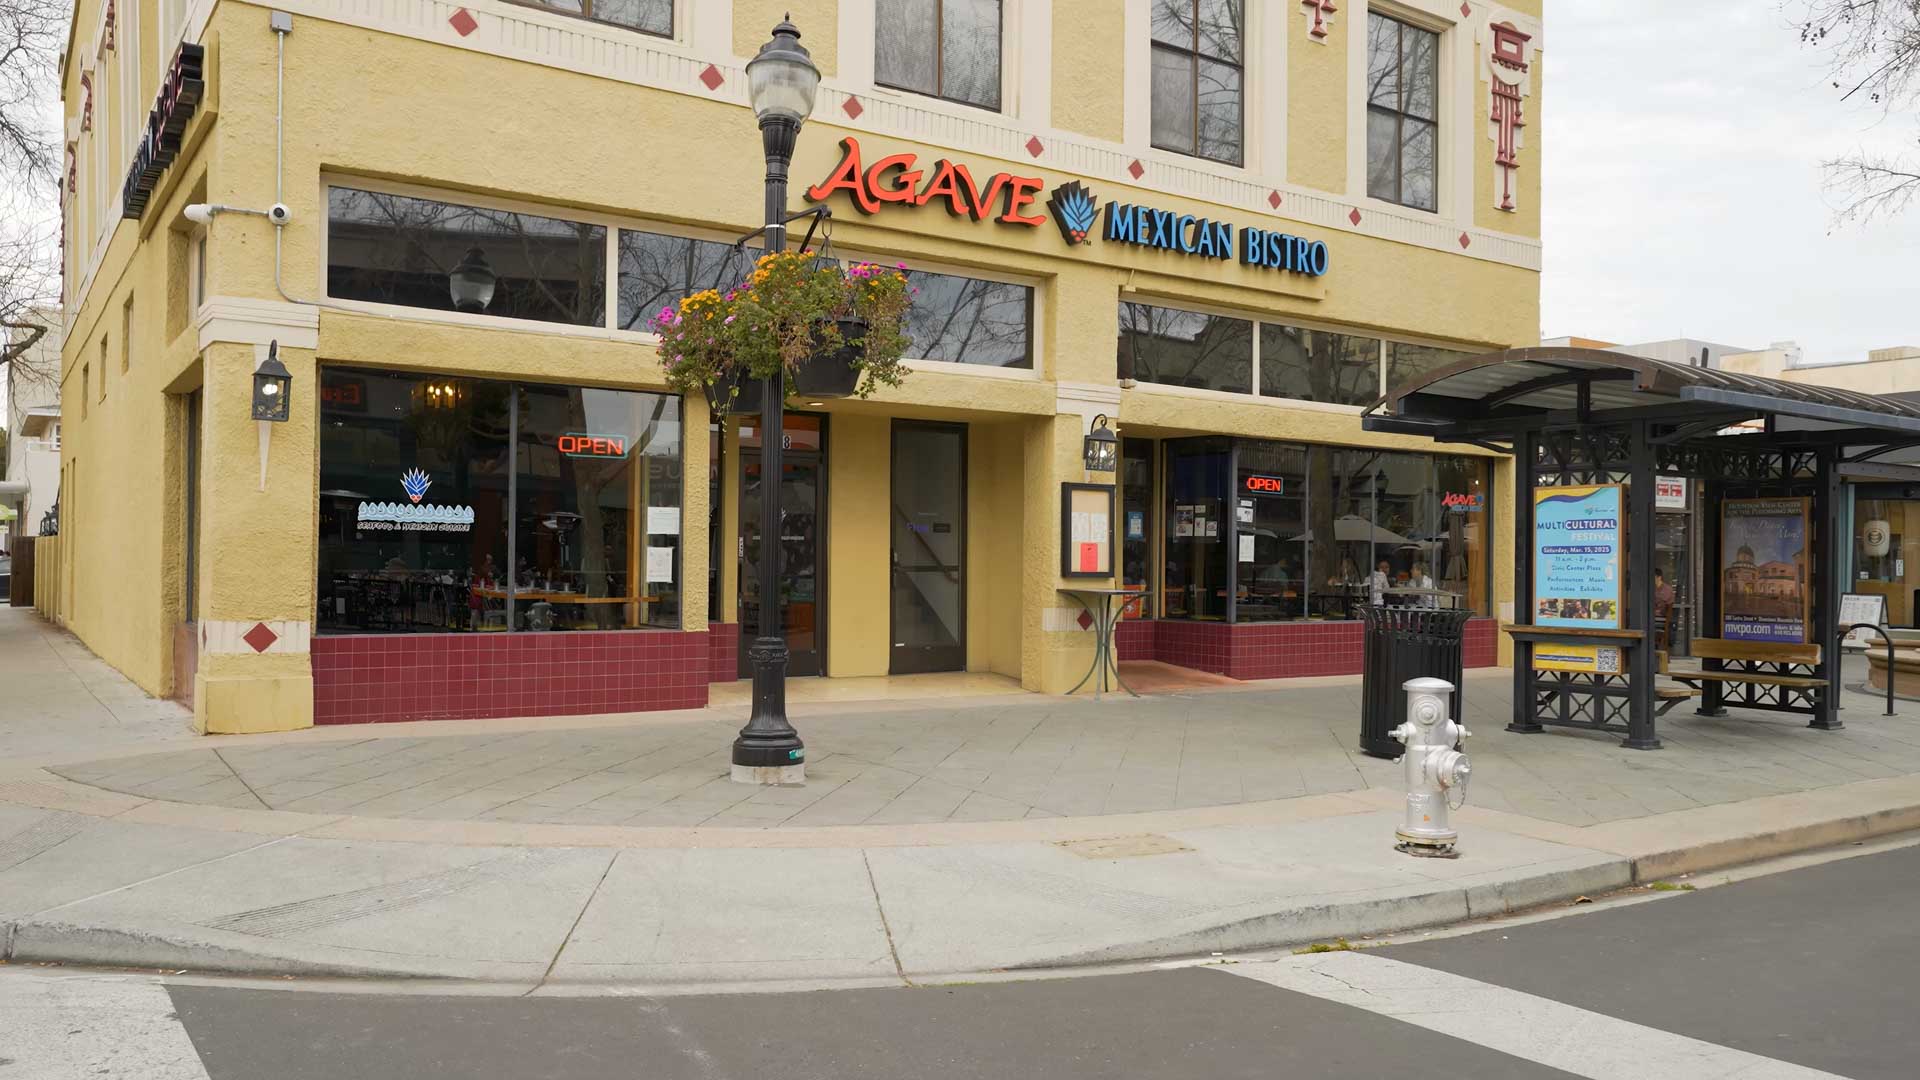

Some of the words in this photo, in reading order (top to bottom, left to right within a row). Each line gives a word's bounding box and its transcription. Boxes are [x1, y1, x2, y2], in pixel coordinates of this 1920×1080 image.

[805, 136, 1047, 227] AGAVE
[1106, 200, 1234, 260] MEXICAN
[1243, 227, 1329, 277] BISTRO
[558, 435, 624, 455] OPEN
[1247, 476, 1281, 492] OPEN
[1441, 491, 1476, 507] AGAVE
[1537, 519, 1616, 530] MULTICULTURAL
[1572, 533, 1616, 541] FESTIVAL
[1725, 623, 1771, 636] mvcpa.com
